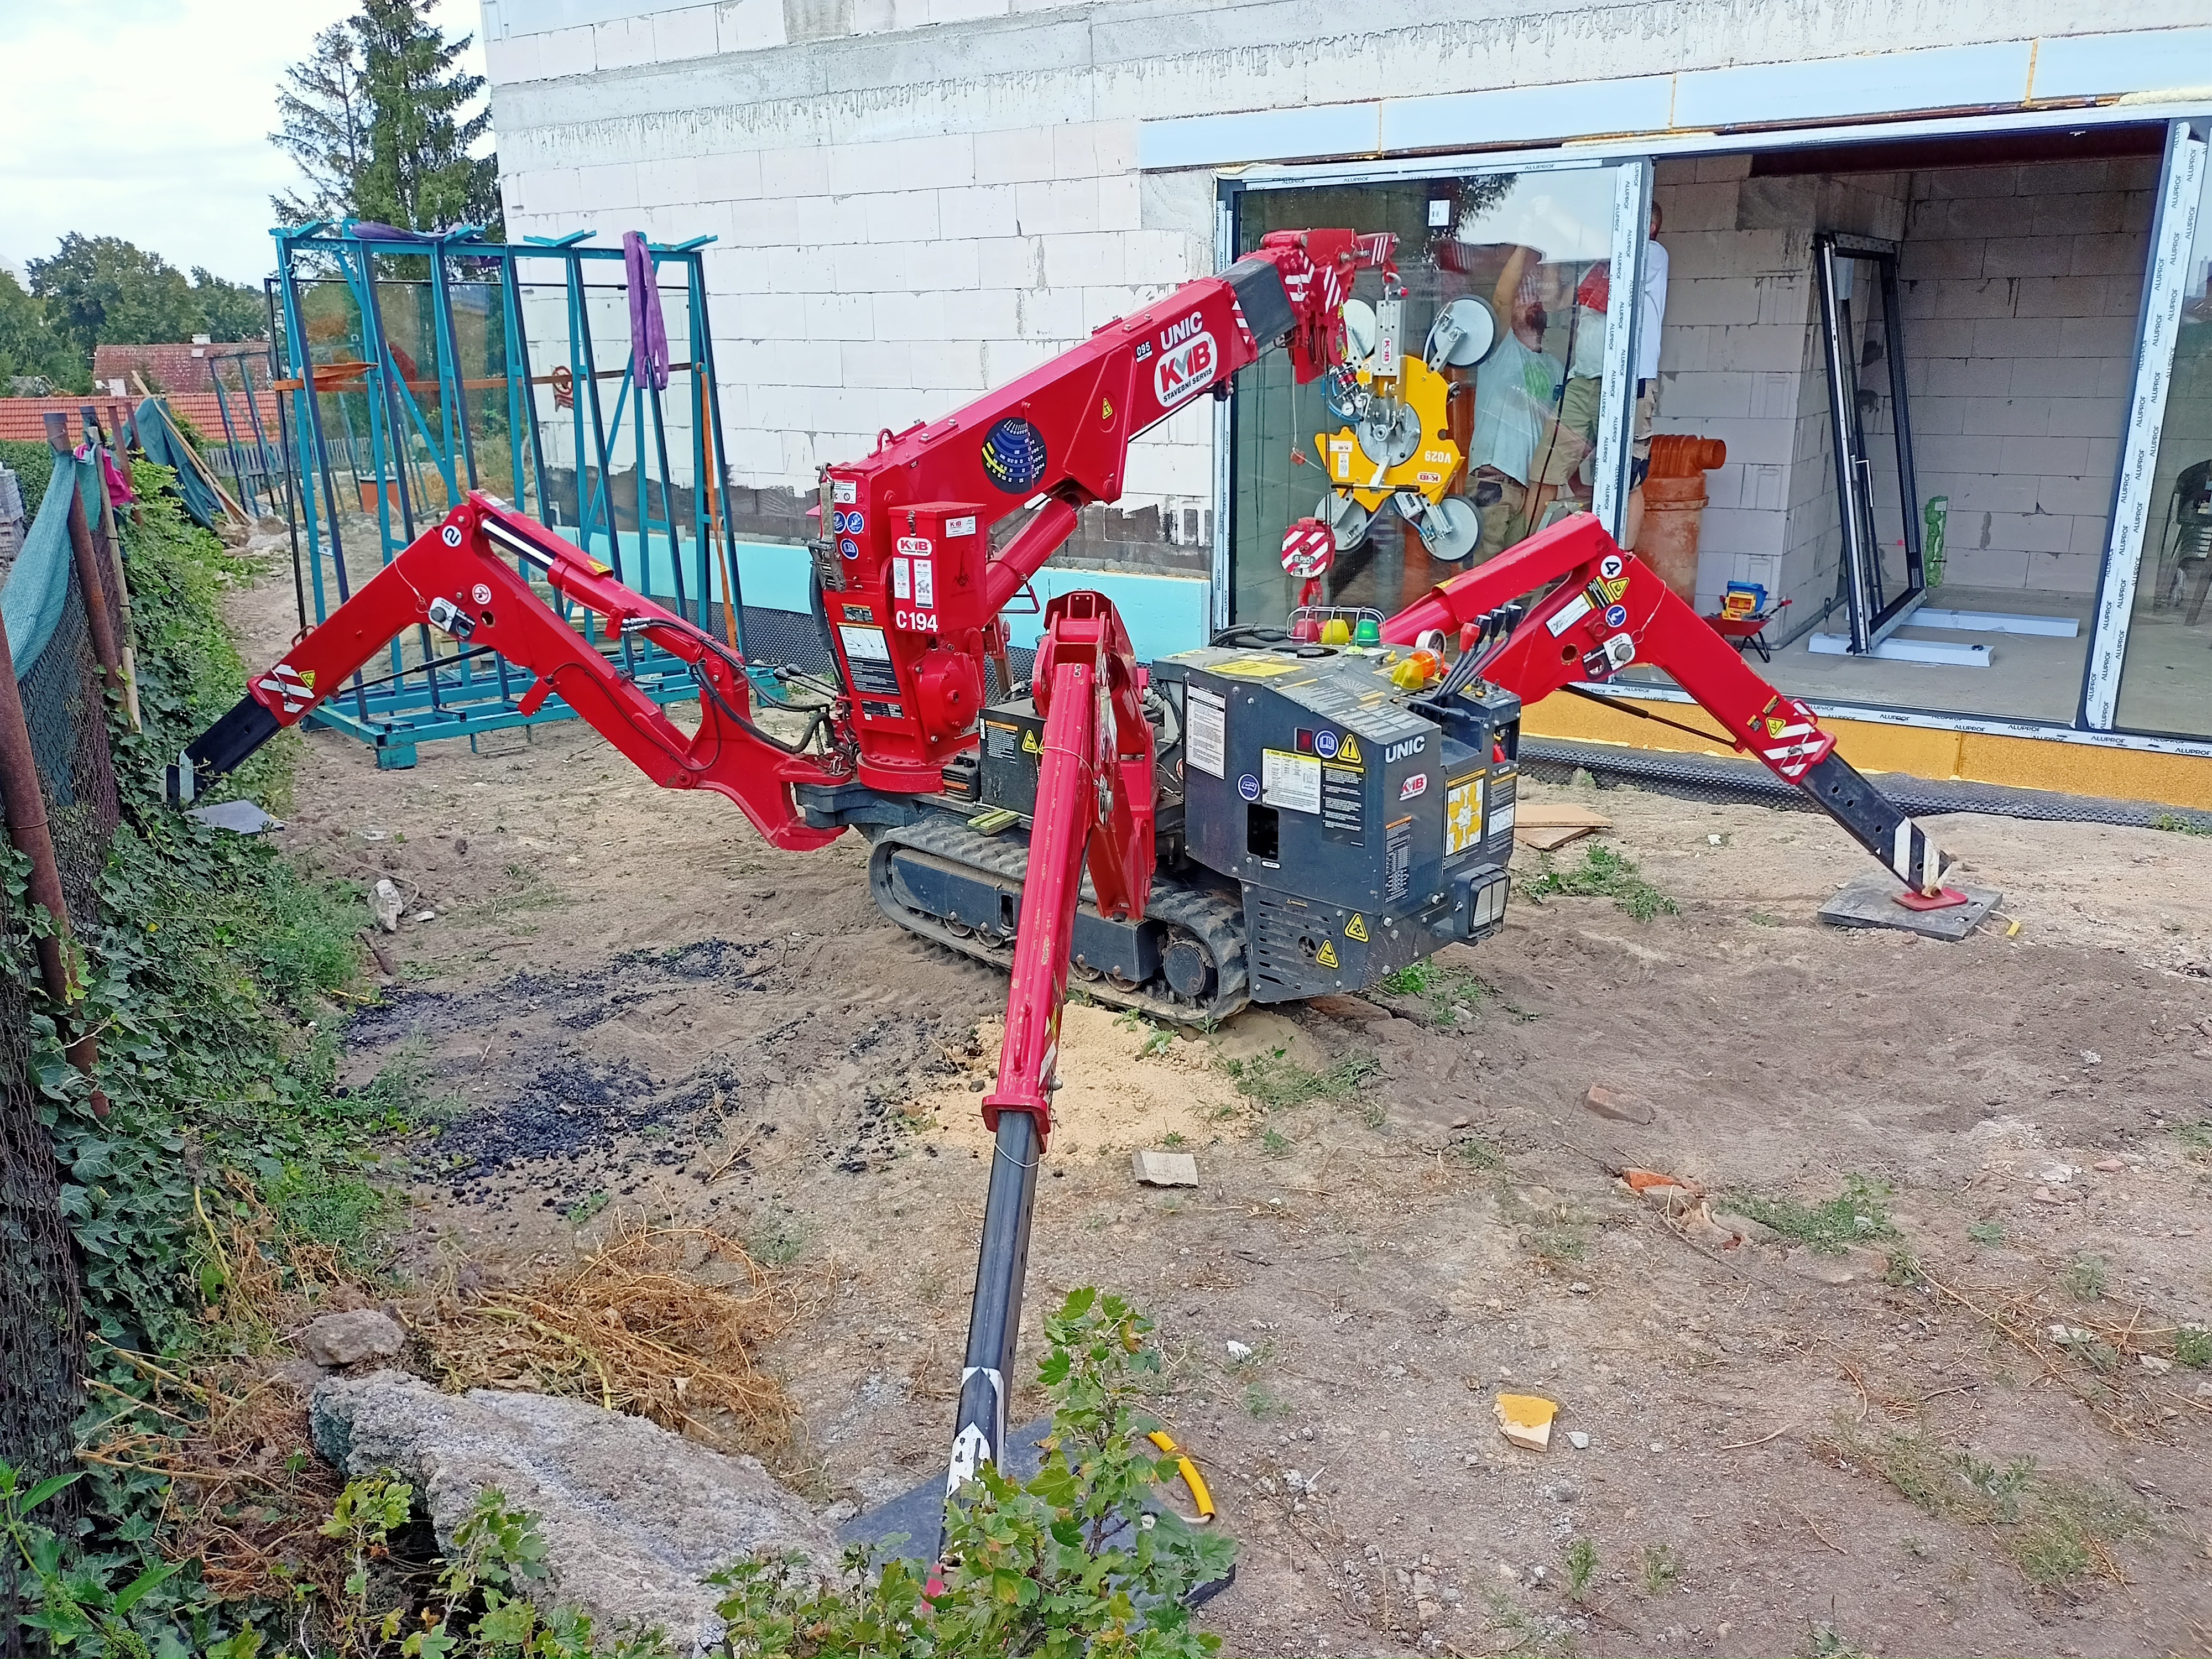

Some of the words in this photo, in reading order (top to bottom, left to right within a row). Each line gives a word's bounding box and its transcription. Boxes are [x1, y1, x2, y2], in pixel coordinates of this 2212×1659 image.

[2187, 148, 2197, 182] ALUPROF
[2172, 175, 2182, 208] ALUPROF
[2185, 206, 2195, 239] ALUPROF
[2170, 232, 2180, 265] ALUPROF
[2154, 257, 2164, 291] ALUPROF
[2168, 288, 2178, 321] ALUPROF
[1160, 311, 1203, 351] UNIC
[2152, 314, 2162, 347] ALUPROF
[1136, 341, 1151, 356] 095
[1164, 380, 1191, 402] STAVEBNÍ
[1192, 368, 1212, 384] SERVIS
[2151, 372, 2161, 403] ALUPROF
[2136, 395, 2146, 427] ALUPROF
[1425, 450, 1452, 463] V029
[2150, 425, 2159, 457] ALUPROF
[2135, 449, 2145, 480] ALUPROF
[2121, 472, 2130, 503] ALUPROF
[2133, 502, 2143, 533] ALUPROF
[445, 528, 460, 544] 2
[2119, 525, 2128, 556] ALUPROF
[1605, 561, 1620, 575] 4
[2117, 578, 2126, 609] ALUPROF
[2103, 600, 2112, 630] ALUPROF
[2115, 629, 2125, 660] ALUPROF
[2101, 651, 2111, 681] ALUPROF
[2088, 672, 2096, 702] ALUPROF
[1880, 713, 1910, 722] ALUPROF
[2100, 701, 2109, 730] ALUPROF
[1385, 736, 1425, 763] UNIC
[2091, 735, 2126, 744] ALUPROF
[2175, 748, 2211, 756] ALUPROF
